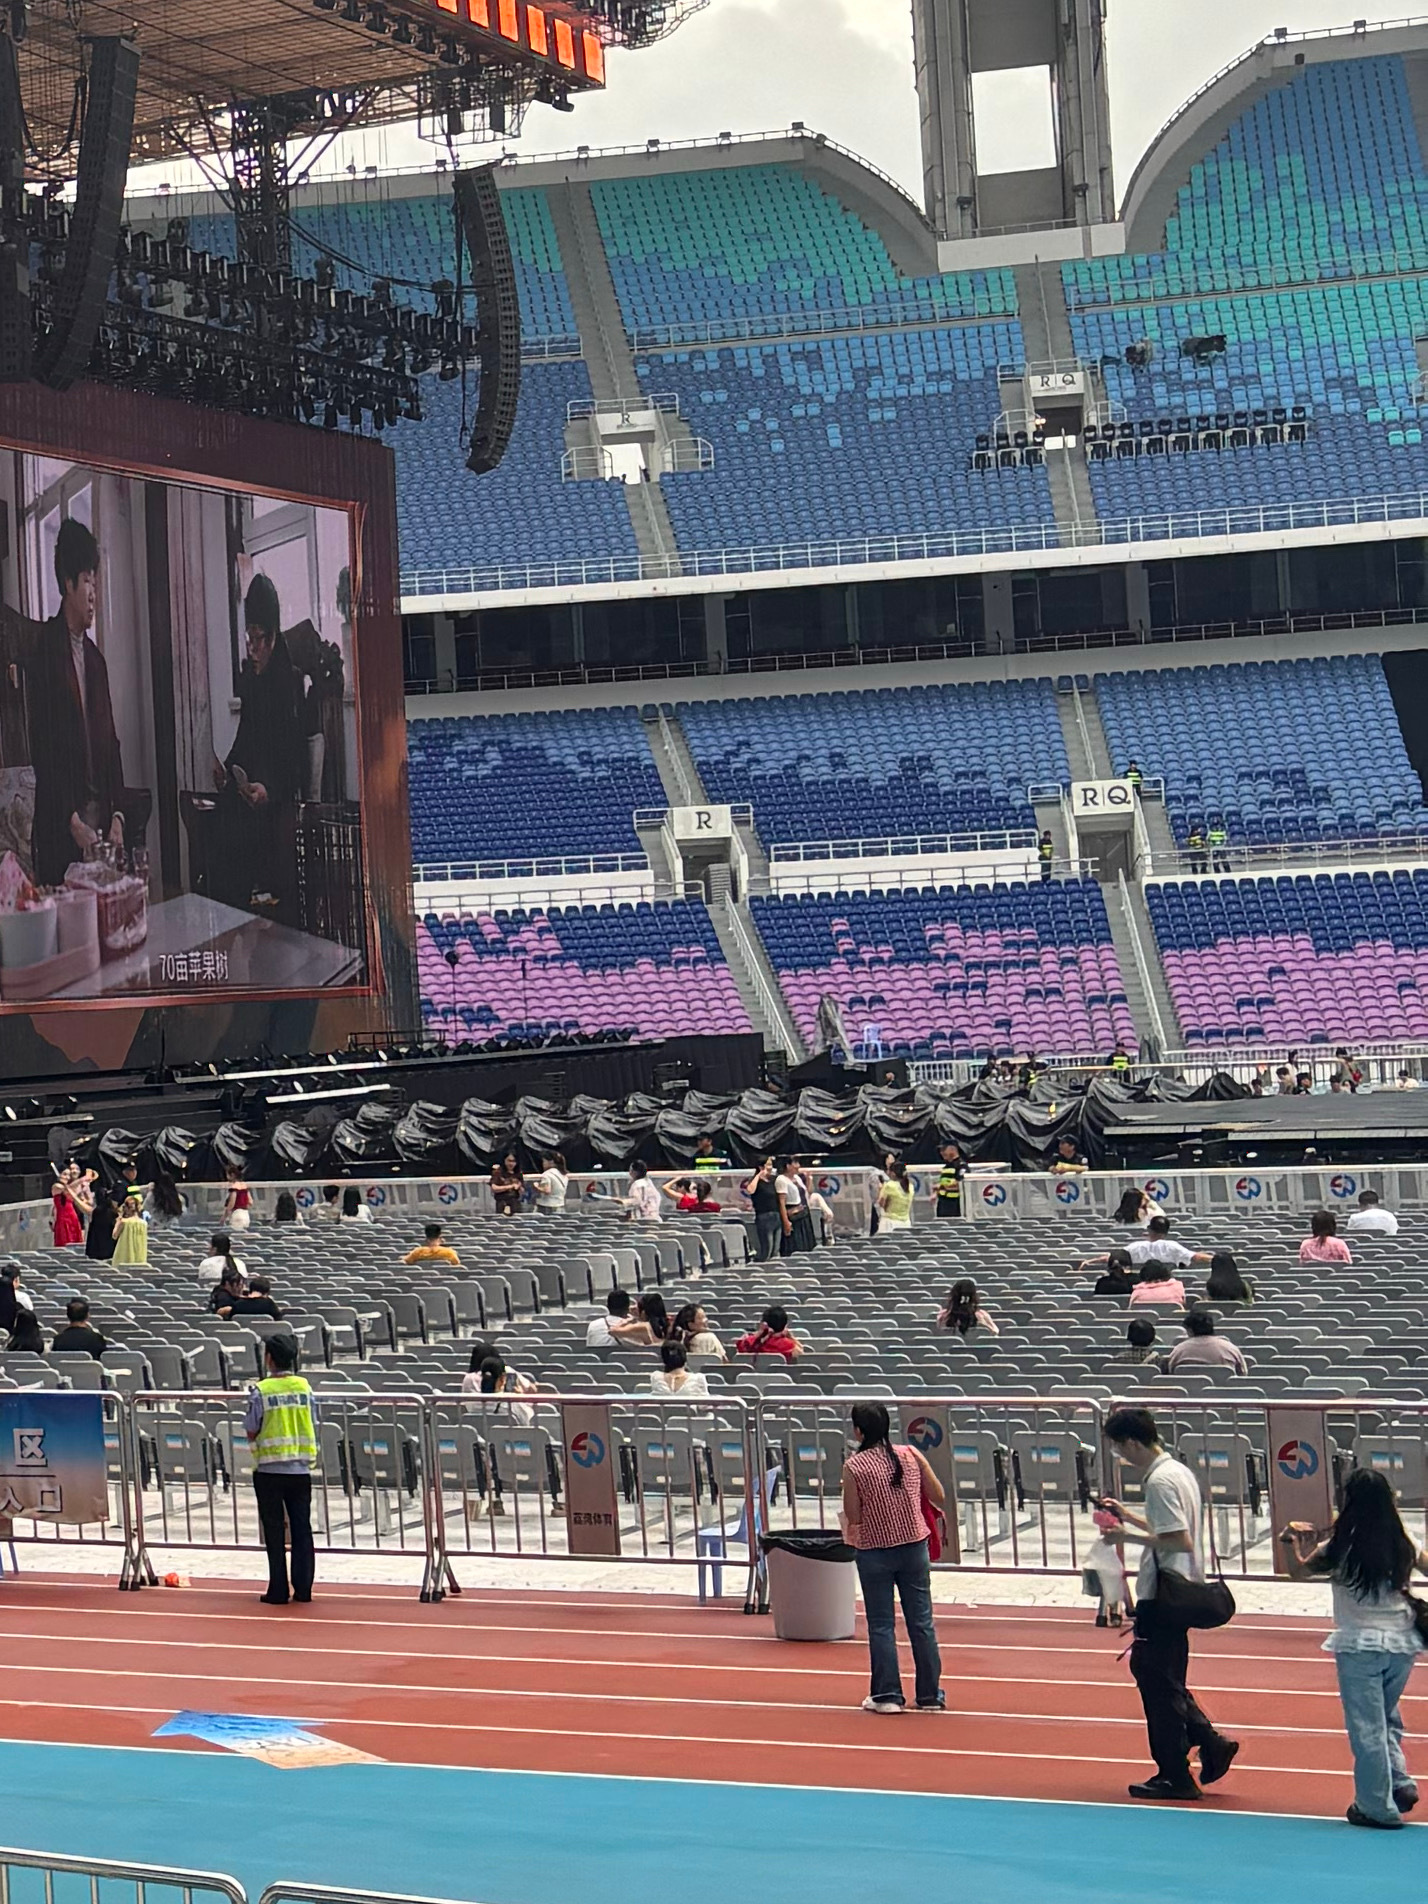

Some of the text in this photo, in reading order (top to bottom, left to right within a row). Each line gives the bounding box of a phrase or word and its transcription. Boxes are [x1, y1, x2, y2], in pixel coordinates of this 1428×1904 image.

[1082, 785, 1131, 807] R Q
[696, 812, 712, 829] R
[158, 950, 229, 982] 70亩苹果树
